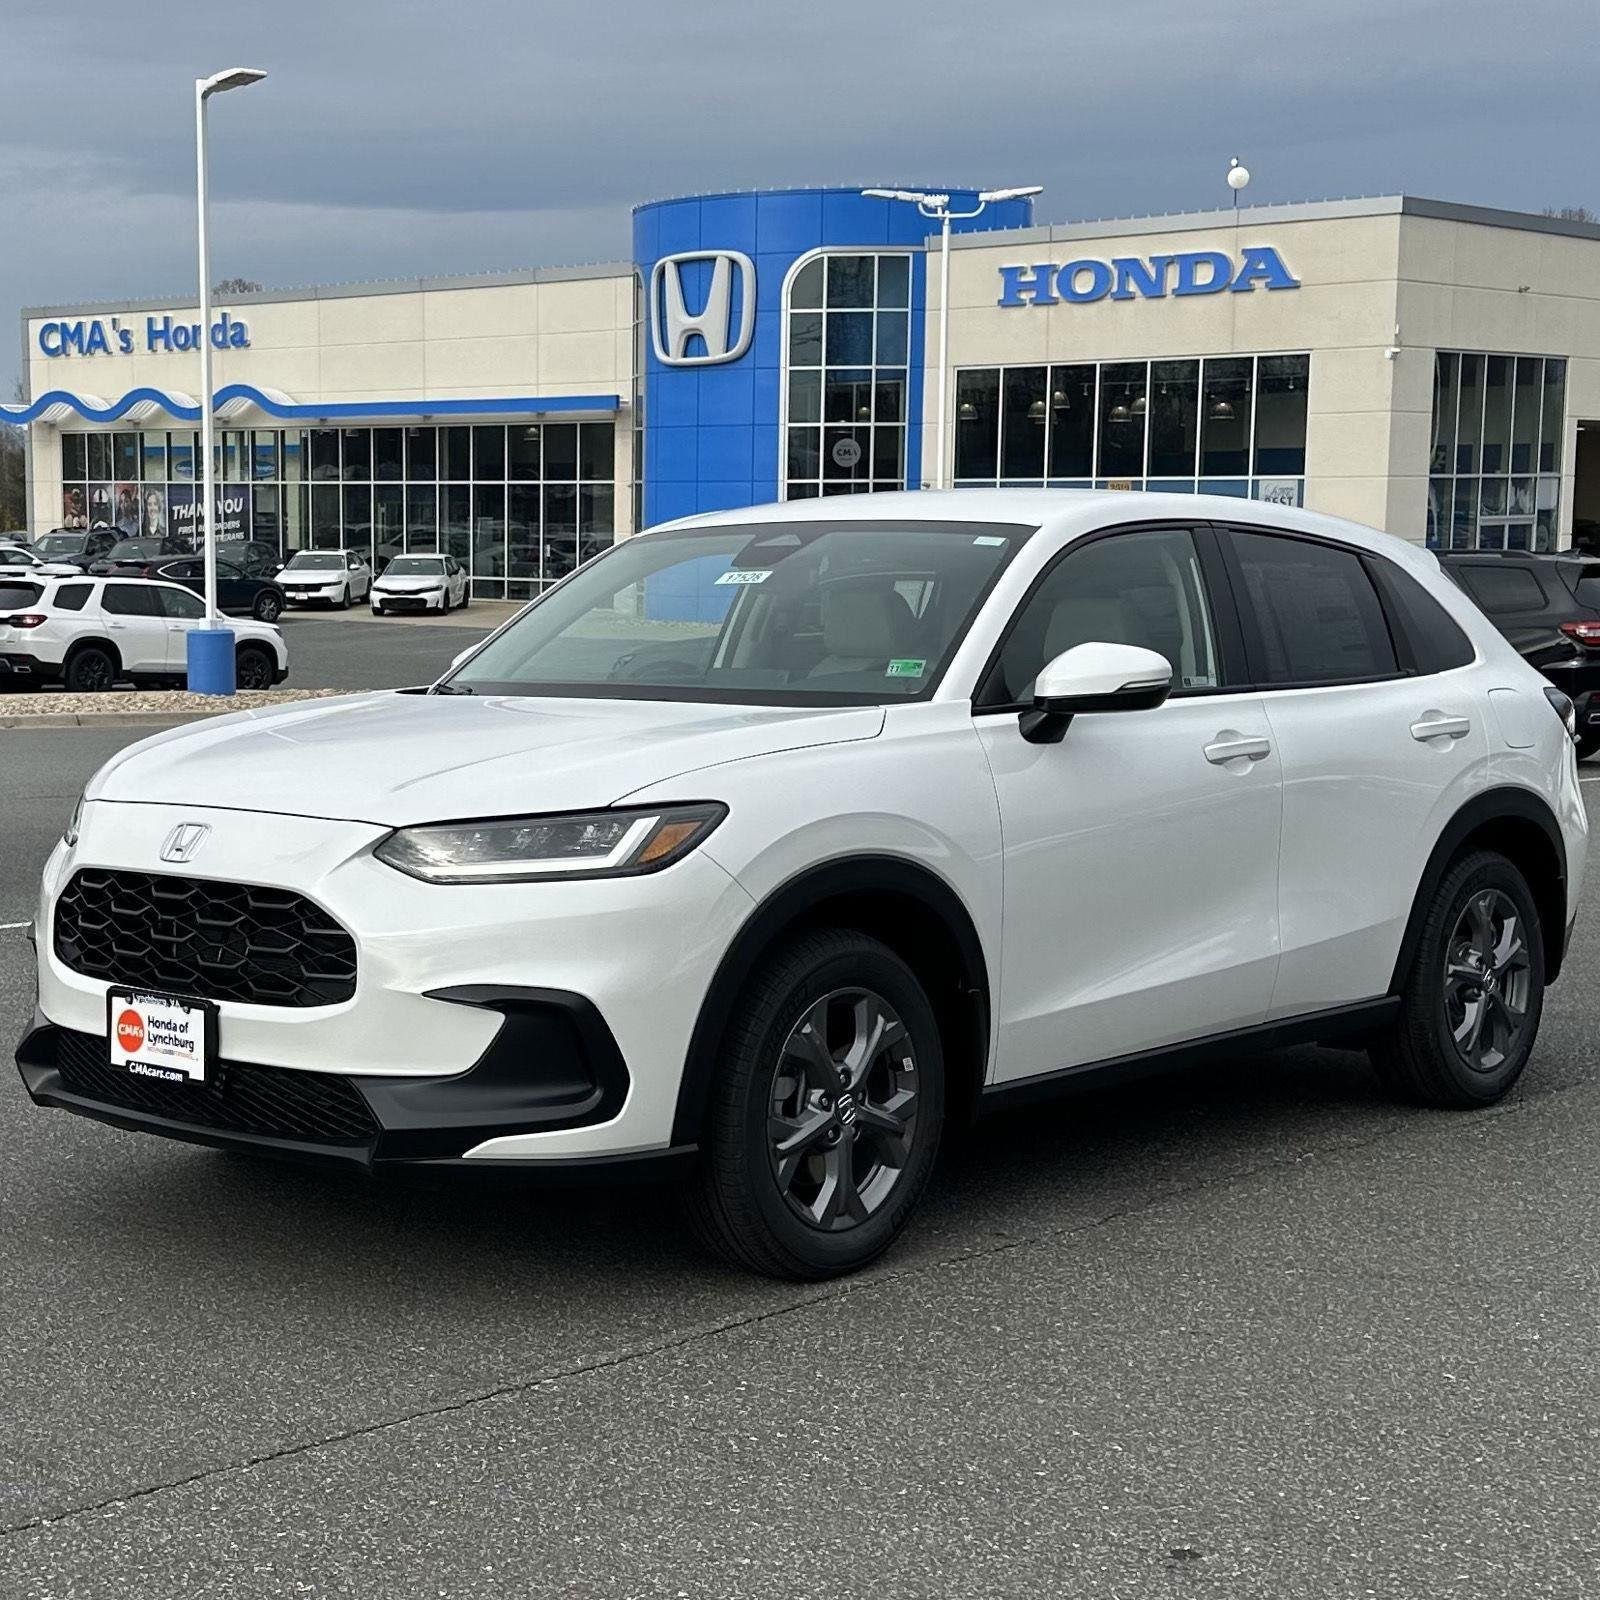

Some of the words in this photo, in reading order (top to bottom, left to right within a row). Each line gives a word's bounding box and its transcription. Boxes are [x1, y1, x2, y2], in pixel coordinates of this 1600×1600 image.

[998, 246, 1301, 307] HONDA
[39, 317, 134, 357] CMA's
[172, 502, 209, 520] THAN
[217, 498, 243, 515] YOU
[148, 1015, 178, 1032] Honda
[178, 1021, 189, 1035] of
[148, 1030, 194, 1053] Lynchburg
[129, 1062, 184, 1082] CMAcars.com
